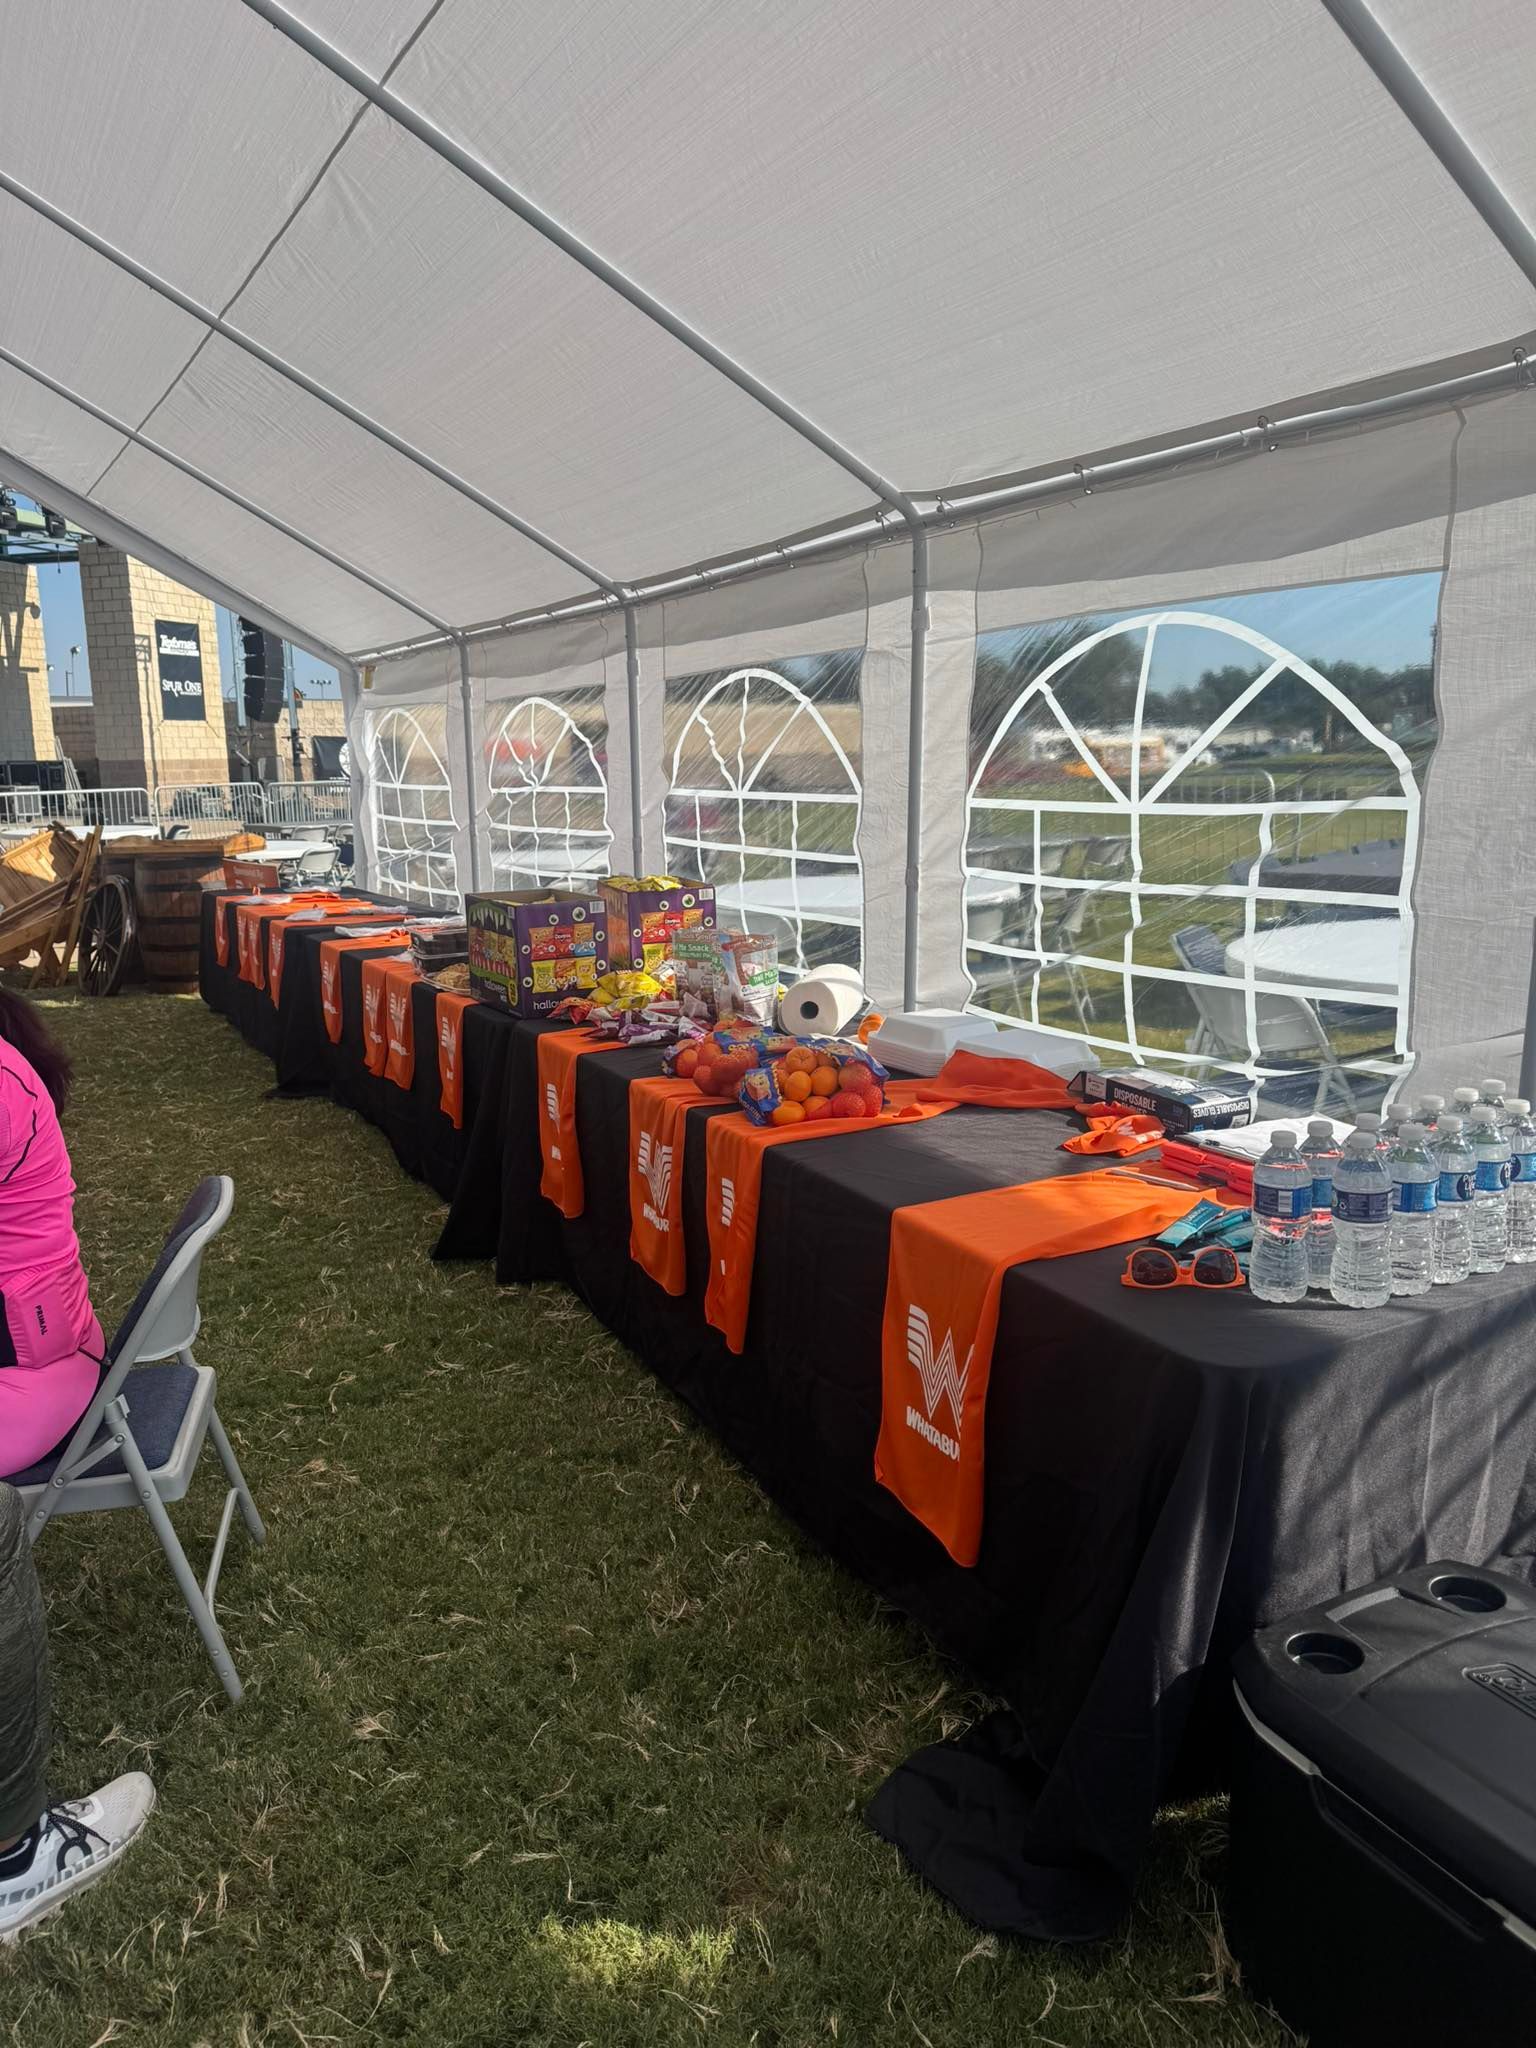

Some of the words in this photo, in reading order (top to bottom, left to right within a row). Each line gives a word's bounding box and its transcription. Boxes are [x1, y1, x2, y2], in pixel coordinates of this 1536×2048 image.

[1113, 1086, 1157, 1112] DISPOSABLE
[1193, 1105, 1216, 1118] GLOVES
[1215, 1100, 1250, 1115] DISPOSABLE
[35, 1304, 49, 1336] PRIMAL
[906, 1405, 960, 1462] WHATABU
